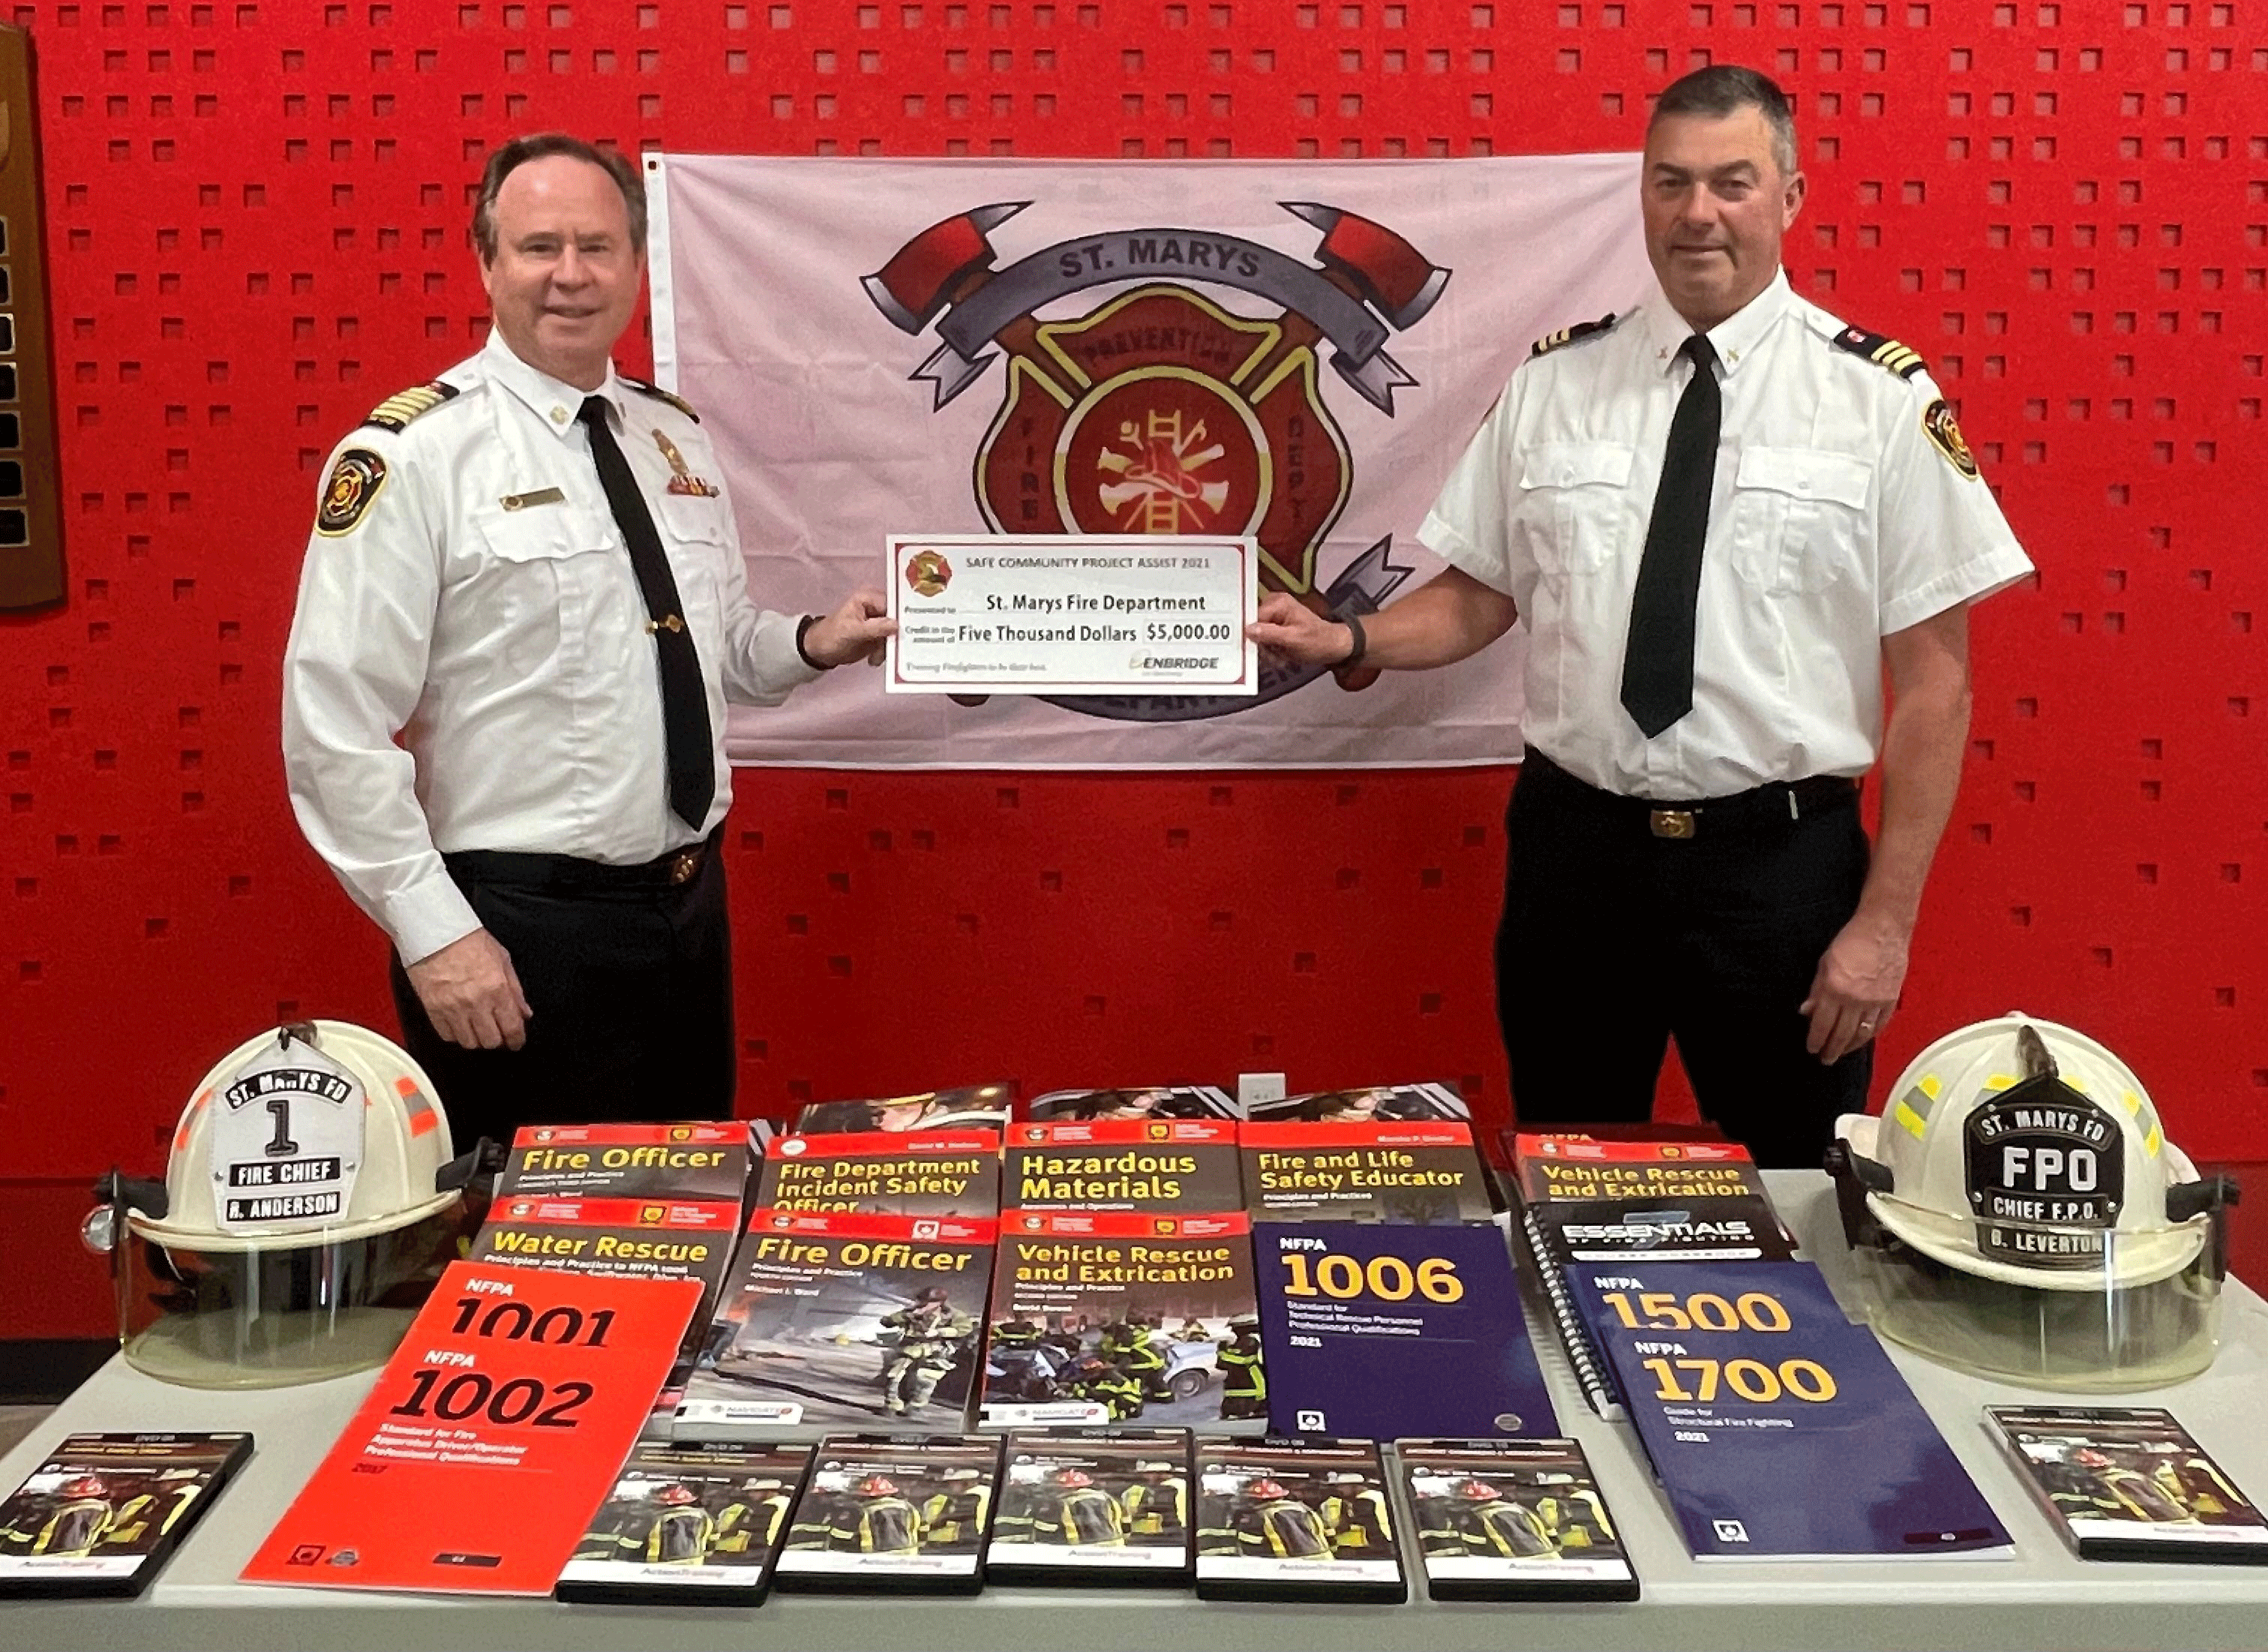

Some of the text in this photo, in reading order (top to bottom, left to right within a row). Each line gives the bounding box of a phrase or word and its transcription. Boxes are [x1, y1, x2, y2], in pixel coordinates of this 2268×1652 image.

[1059, 239, 1259, 278] ST. MARYS
[965, 557, 1210, 569] SAFE COMMUNITY PROJECT ASSIST 2021
[986, 593, 1206, 614] St. Marys Fire Department
[958, 625, 1137, 642] Five Thousand Dollars
[1146, 623, 1231, 642] $5,000.00
[1143, 656, 1220, 669] ENBRIDGE
[228, 1083, 256, 1107] ST.
[324, 1078, 347, 1101] FD
[265, 1099, 298, 1157] 1
[1982, 1110, 2105, 1141] ST. MARYS FD
[522, 1146, 727, 1171] Fire Officer
[1022, 1152, 1198, 1176] Hazardous
[1258, 1150, 1414, 1170] Fire and Life
[2002, 1146, 2097, 1192] FPO
[238, 1161, 332, 1185] FIRE CHIEF
[779, 1159, 981, 1180] Fire Department
[1541, 1164, 1740, 1182] Vehicle Rescue
[777, 1176, 968, 1198] Incident Safety
[1021, 1176, 1181, 1200] Materials
[1260, 1170, 1464, 1191] Safety Educator
[1548, 1182, 1750, 1198] and Extrication
[250, 1194, 337, 1218] ANDERSON
[1993, 1197, 2044, 1220] CHIEF
[1562, 1221, 1752, 1239] ESSENTIALS
[494, 1231, 709, 1263] Water Rescue
[1279, 1237, 1328, 1252] NFPA
[2015, 1232, 2103, 1253] LEVERTON
[756, 1237, 972, 1272] Fire Officer
[1017, 1243, 1231, 1264] Vehicle Rescue
[1016, 1263, 1234, 1283] and Extrication
[1280, 1253, 1465, 1303] 1006
[1593, 1277, 1645, 1290] NFPA
[464, 1278, 514, 1298] NFPA
[452, 1297, 616, 1348] 1001
[1602, 1292, 1792, 1332] 1500
[423, 1350, 476, 1368] NFPA
[1633, 1341, 1688, 1356] NFPA
[1642, 1358, 1838, 1403] 1700
[388, 1369, 594, 1428] 1002
